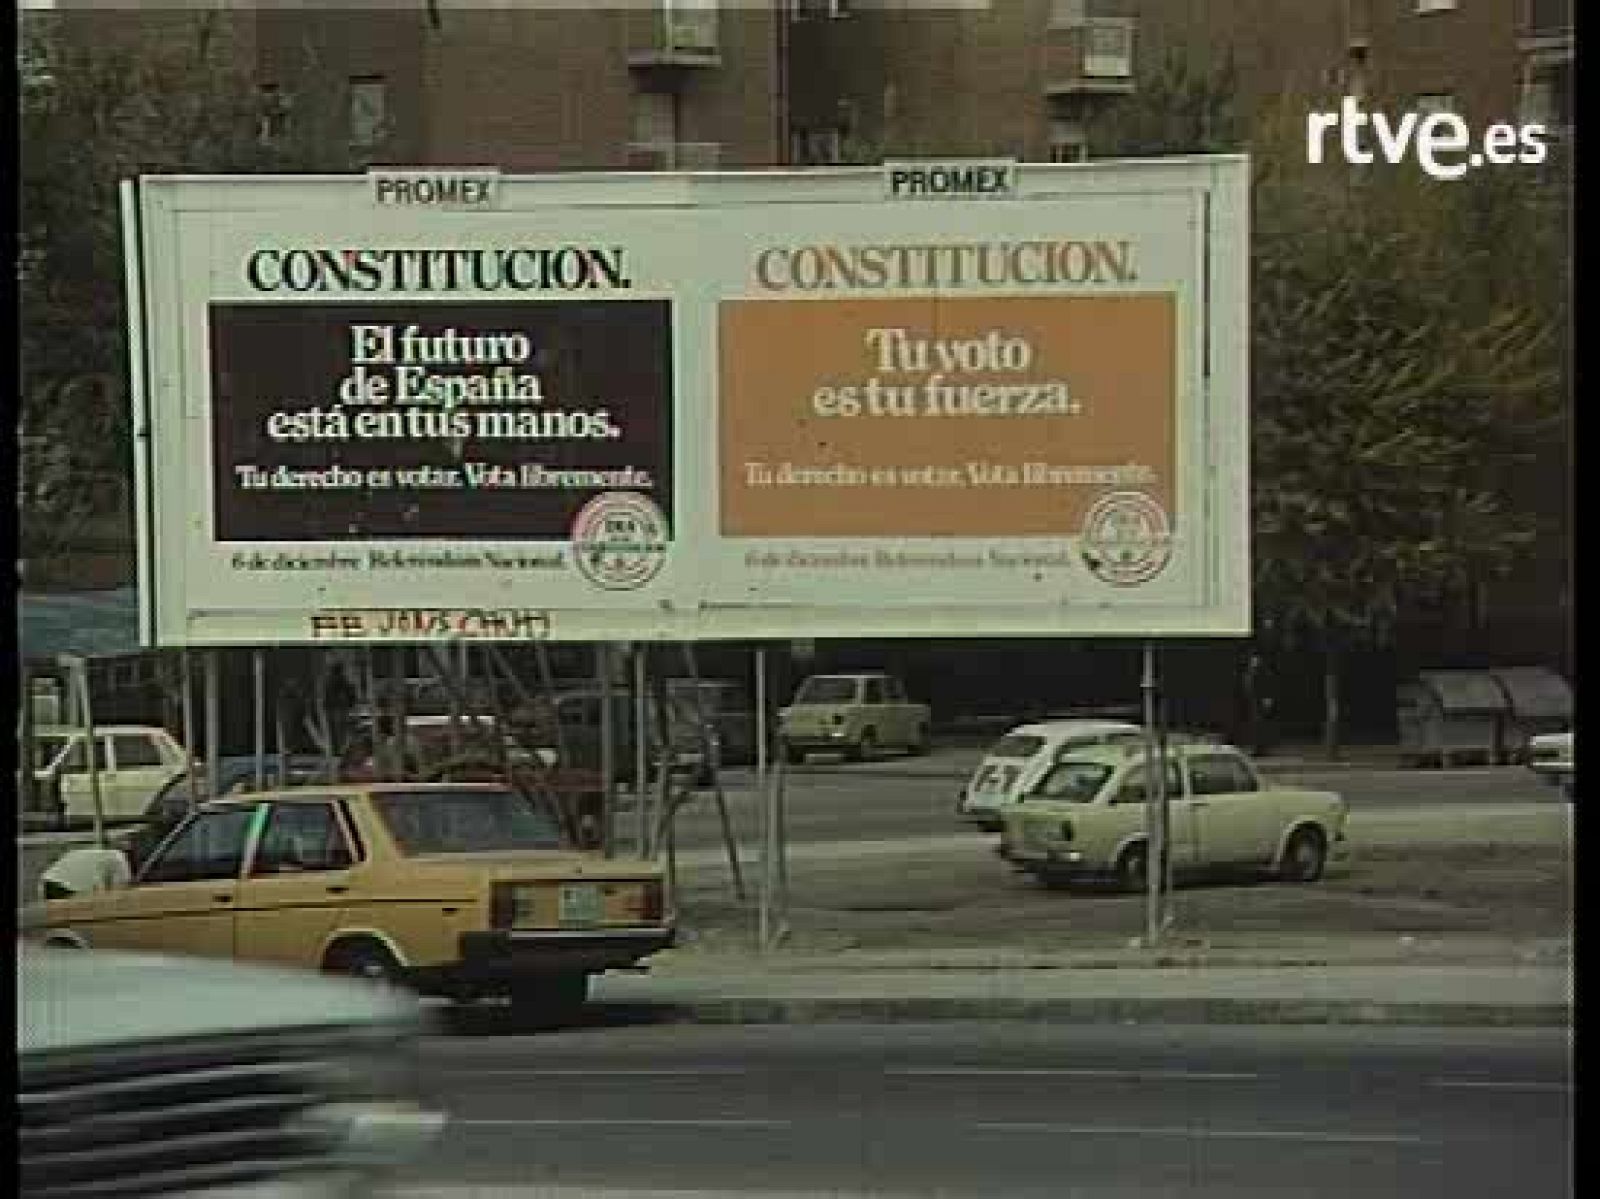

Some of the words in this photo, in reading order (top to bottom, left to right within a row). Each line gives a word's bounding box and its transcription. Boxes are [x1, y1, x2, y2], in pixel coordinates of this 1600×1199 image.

[376, 178, 491, 205] PROMEX
[891, 167, 1009, 195] PROMEX
[247, 247, 632, 292] CONSTITUCION.
[755, 241, 1139, 290] CONSTITUCION.
[350, 325, 395, 364] El
[399, 325, 531, 364] futuro
[864, 328, 928, 371] Tu
[934, 330, 1032, 371] voto
[340, 366, 390, 405] de
[394, 366, 544, 409] España
[813, 386, 862, 417] es
[866, 378, 920, 417] tu
[923, 374, 1083, 417] fuerza.
[267, 404, 351, 440] está
[353, 410, 402, 439] en
[404, 406, 473, 439] tus
[476, 409, 622, 439] manos.
[234, 465, 268, 489] Tu
[270, 465, 362, 489] derecho
[465, 463, 516, 488] Vota
[521, 464, 653, 488] libremente.
[744, 463, 772, 485] Tu
